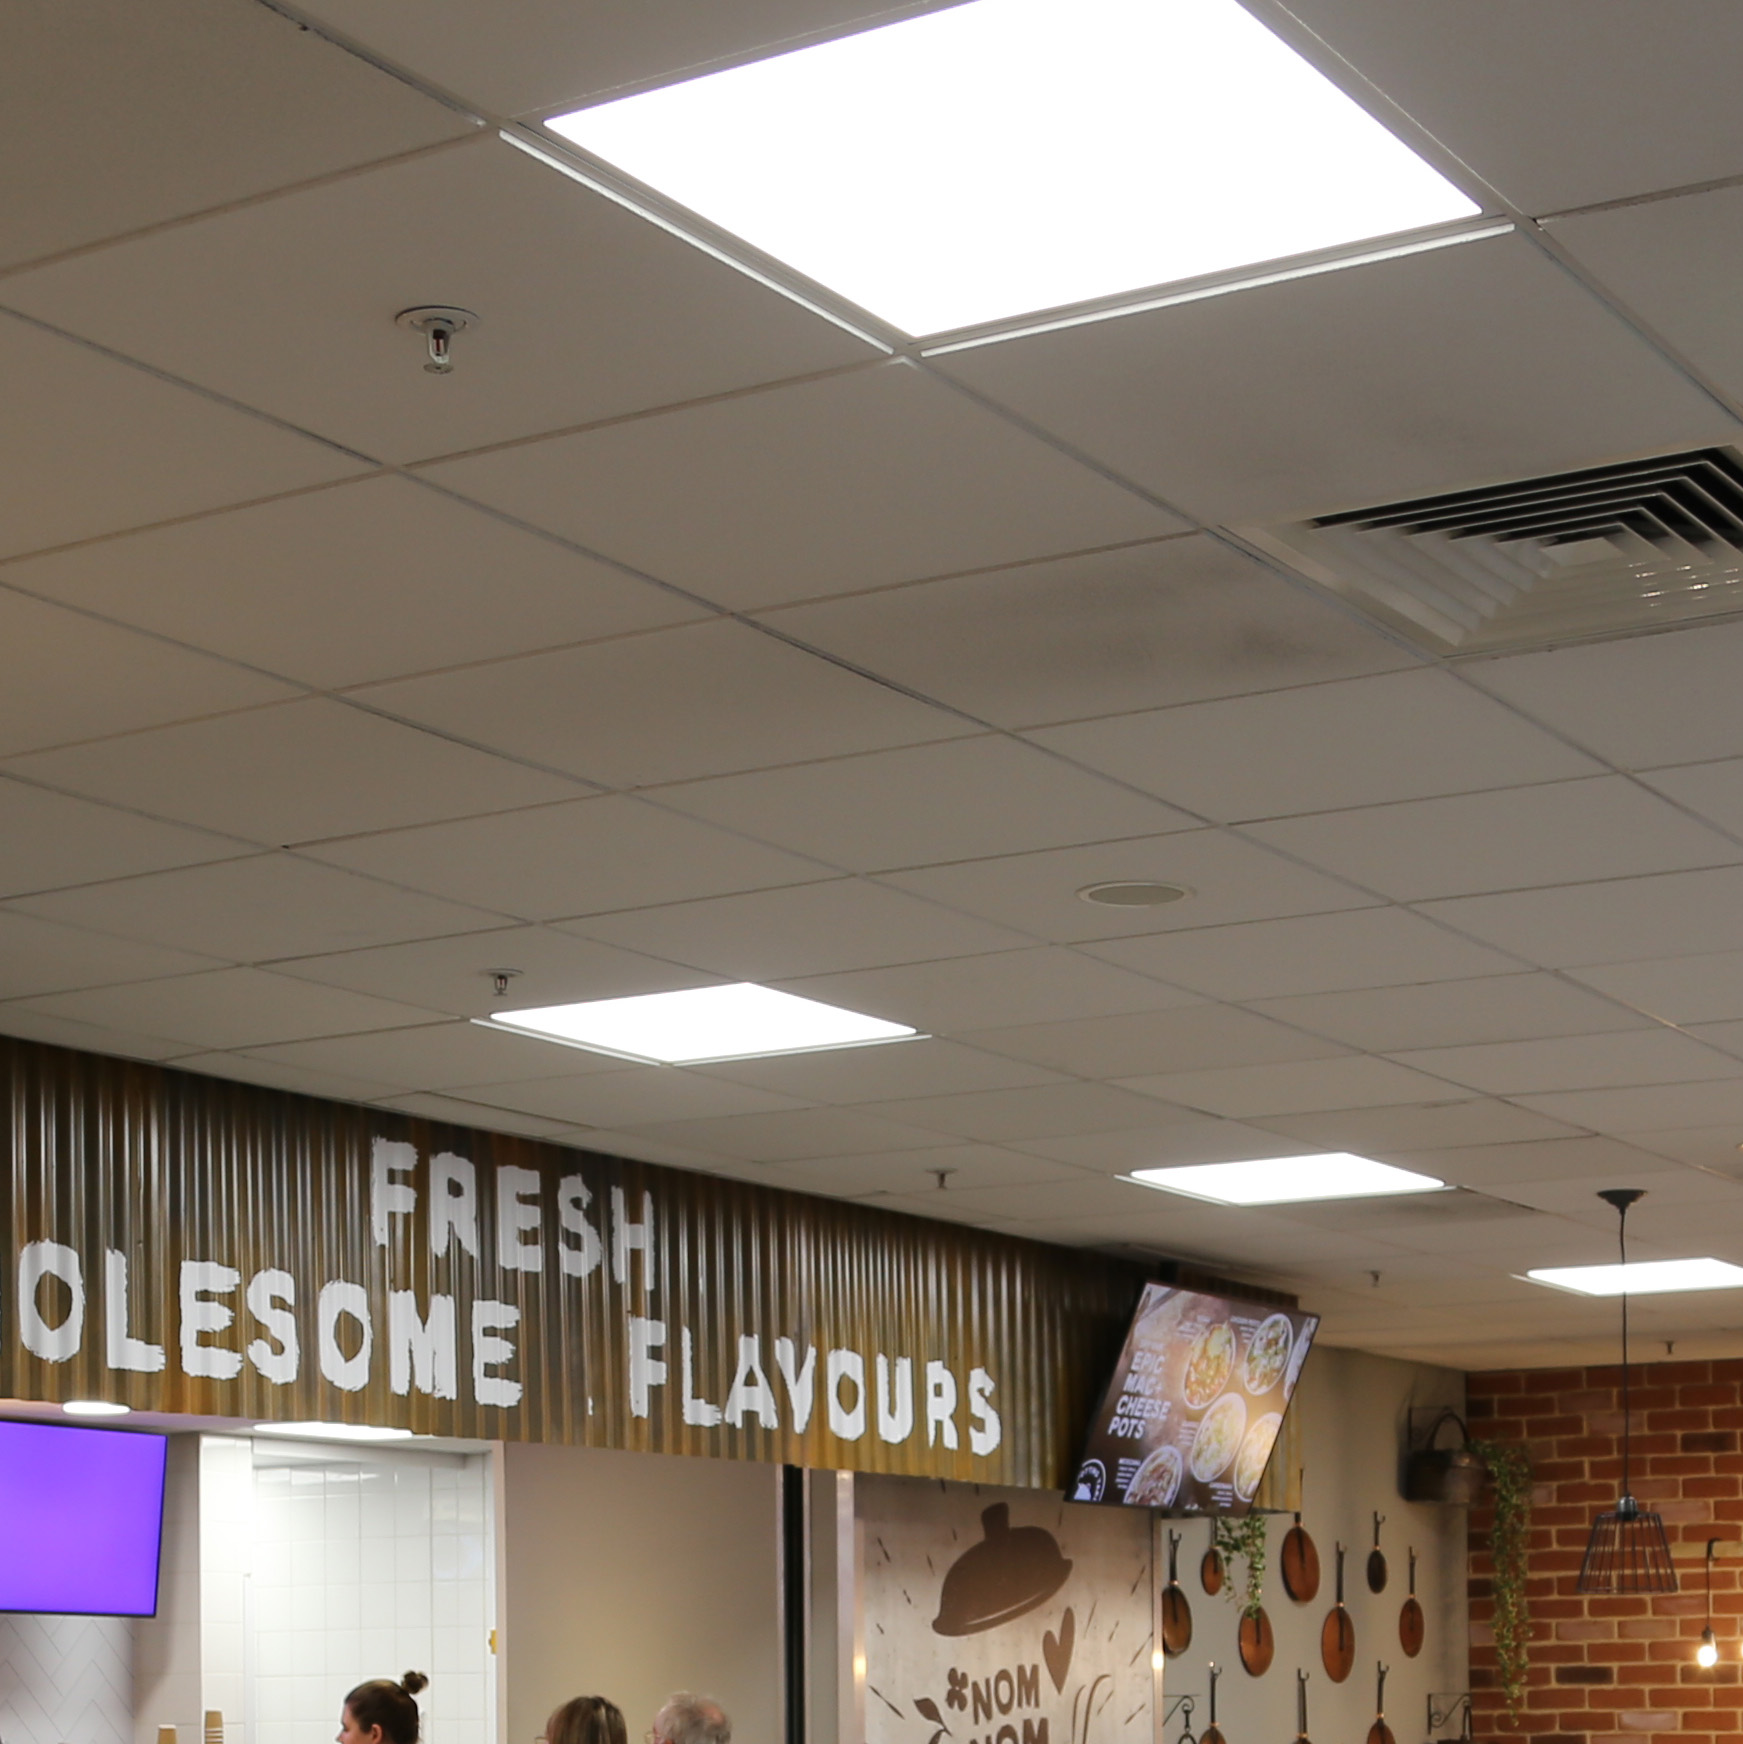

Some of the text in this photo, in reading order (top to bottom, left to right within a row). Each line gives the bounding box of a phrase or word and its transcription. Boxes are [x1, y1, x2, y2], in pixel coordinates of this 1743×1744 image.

[371, 1135, 655, 1292] FRESH
[1131, 1351, 1165, 1374] EPIC
[629, 1315, 1002, 1457] FLAVOURS
[1116, 1395, 1172, 1420] CHEESE
[1108, 1415, 1146, 1439] POTS
[972, 1664, 1040, 1725] NOM
